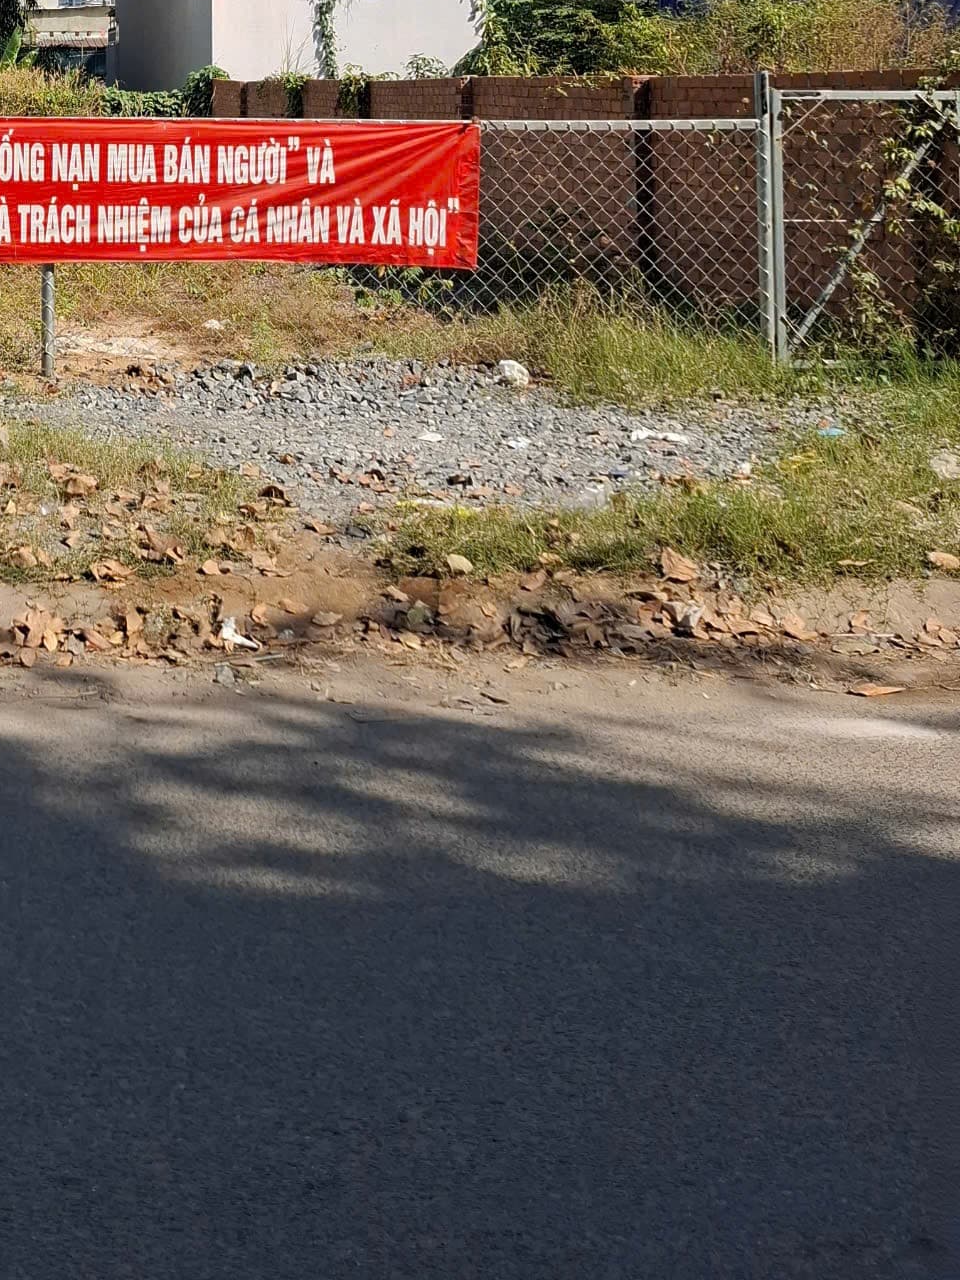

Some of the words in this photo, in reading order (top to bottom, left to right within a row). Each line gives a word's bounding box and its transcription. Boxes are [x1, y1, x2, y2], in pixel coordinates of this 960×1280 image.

[52, 143, 100, 191] NẠN
[107, 143, 157, 183] MUA
[163, 136, 211, 184] BÁN
[306, 138, 336, 184] VÀ
[17, 196, 91, 244] TRÁCH
[97, 197, 172, 252] NHIỆM
[178, 193, 224, 244] CỦA
[229, 197, 260, 244] CÁ
[266, 198, 330, 245] NHÂN
[336, 197, 366, 245] VÀ
[371, 198, 403, 246] XÃ
